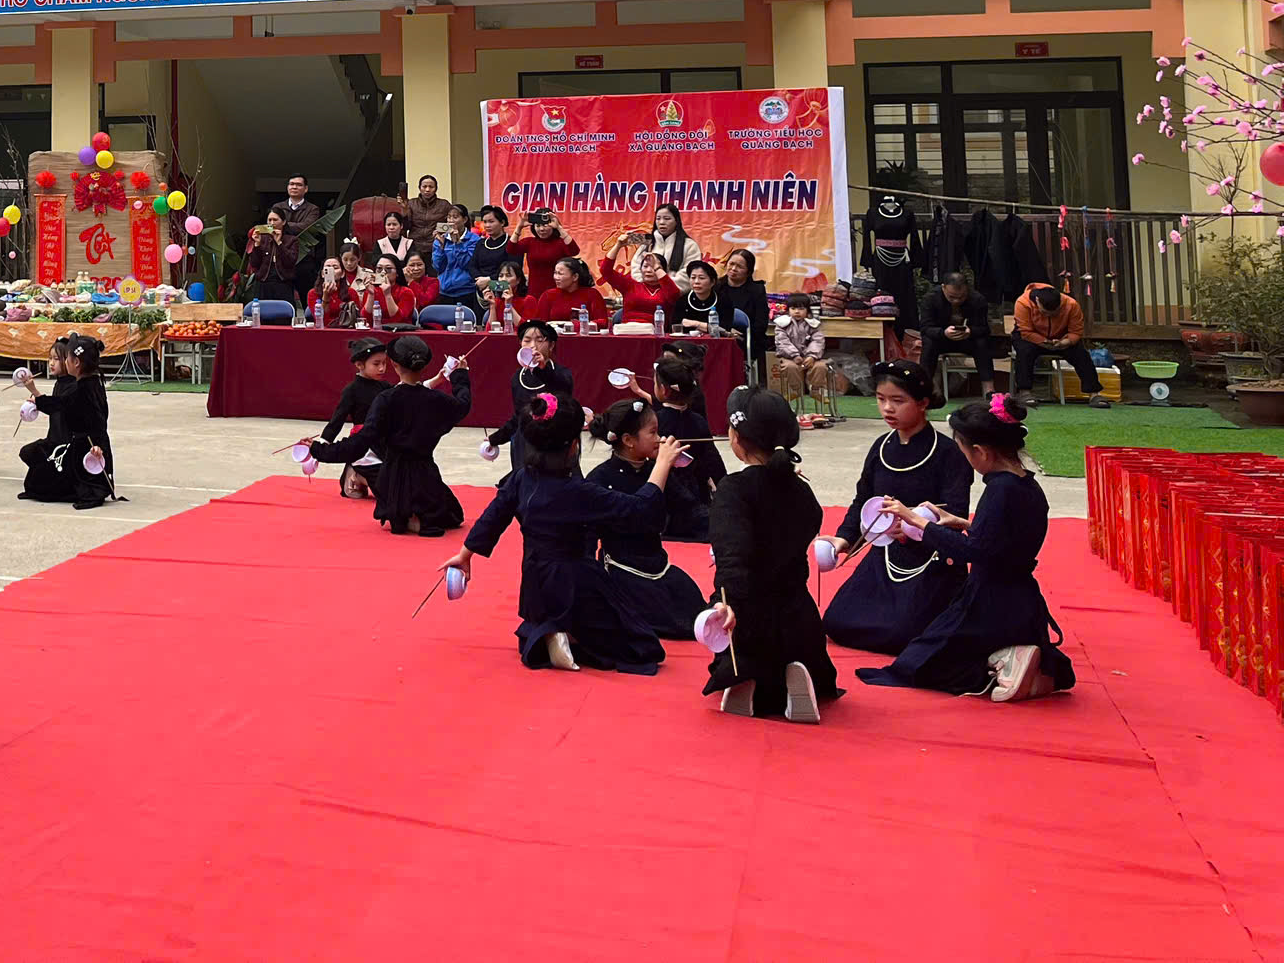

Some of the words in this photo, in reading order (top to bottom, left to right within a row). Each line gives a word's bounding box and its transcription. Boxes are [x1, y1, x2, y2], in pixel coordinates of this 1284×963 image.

[526, 135, 550, 143] TNCS
[552, 130, 567, 142] HỒ
[569, 133, 587, 142] CHÍ
[589, 133, 615, 142] MINH
[635, 130, 653, 143] HỘI
[689, 128, 709, 141] ĐỘI
[728, 127, 772, 139] TRƯỜNG
[774, 125, 796, 138] TIỂU
[798, 128, 823, 140] HỌC
[530, 142, 566, 153] QUẢNG
[568, 143, 597, 155] BẠCH
[645, 140, 683, 151] QUẢNG
[685, 141, 716, 153] BẠCH
[741, 138, 781, 150] QUẢNG
[783, 140, 814, 152] BẠCH
[500, 182, 566, 214] GIAN
[570, 172, 648, 214] HÀNG
[653, 180, 745, 213] THANH
[750, 170, 819, 212] NIÊN
